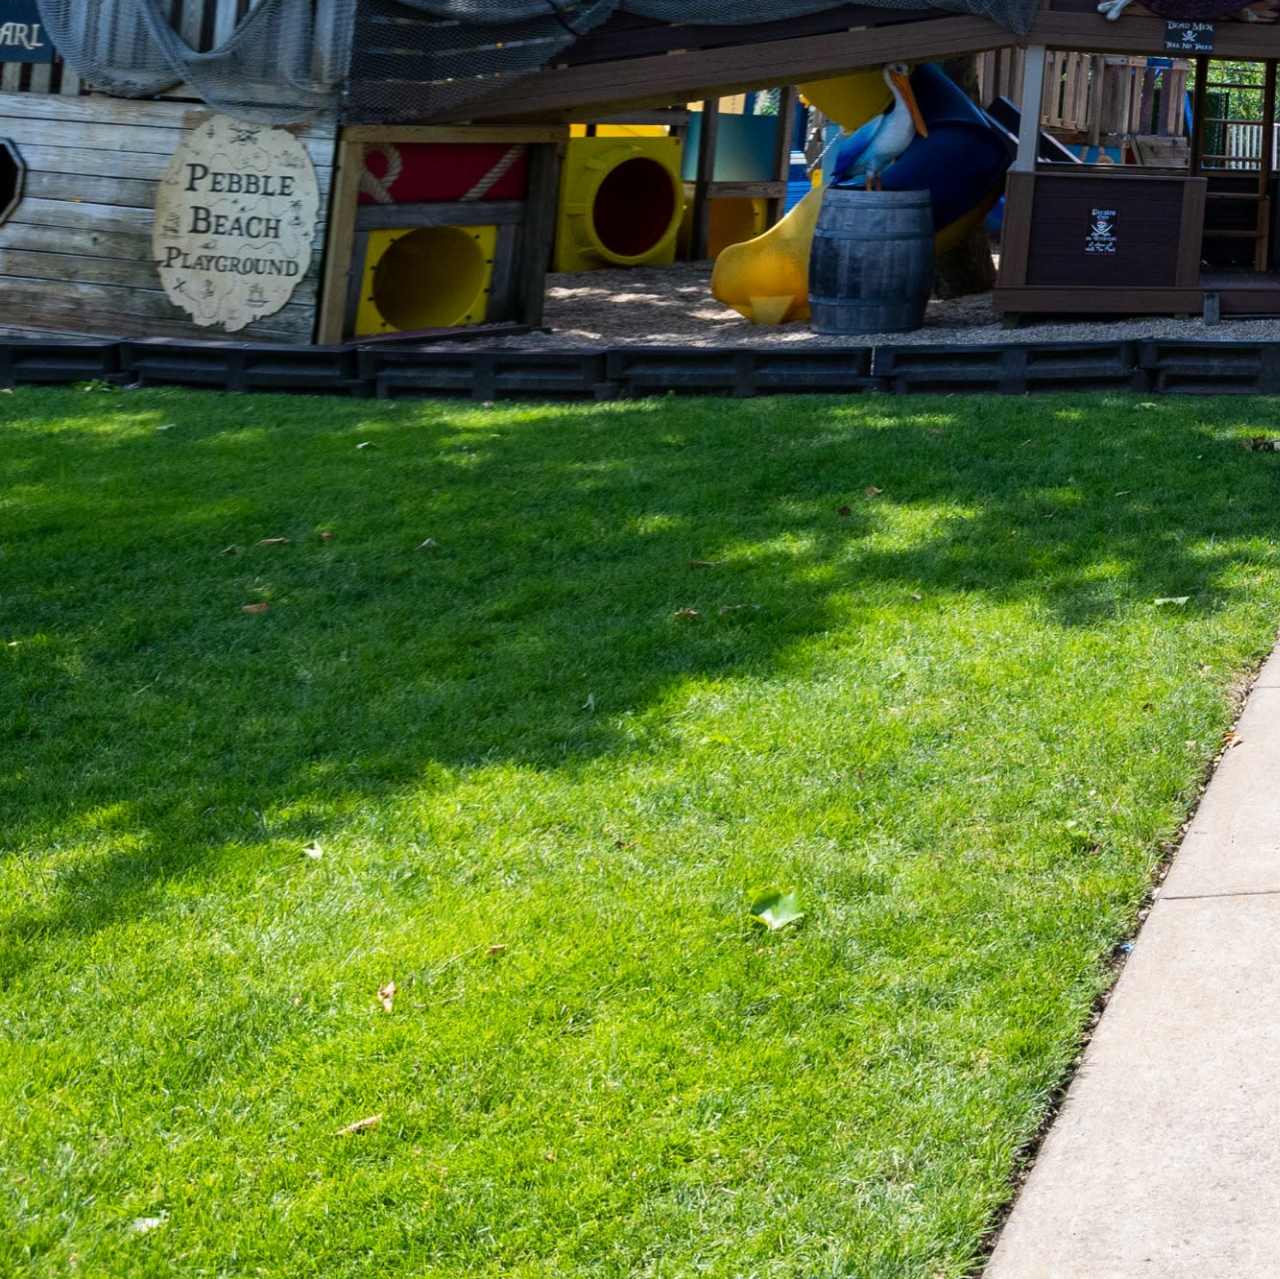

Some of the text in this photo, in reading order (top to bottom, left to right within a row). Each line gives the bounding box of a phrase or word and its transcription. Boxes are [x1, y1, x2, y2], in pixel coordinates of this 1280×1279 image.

[0, 22, 45, 48] ARL
[184, 163, 296, 197] PEBBLE
[188, 205, 282, 239] BEACH
[162, 246, 299, 277] PLAYGROUND
